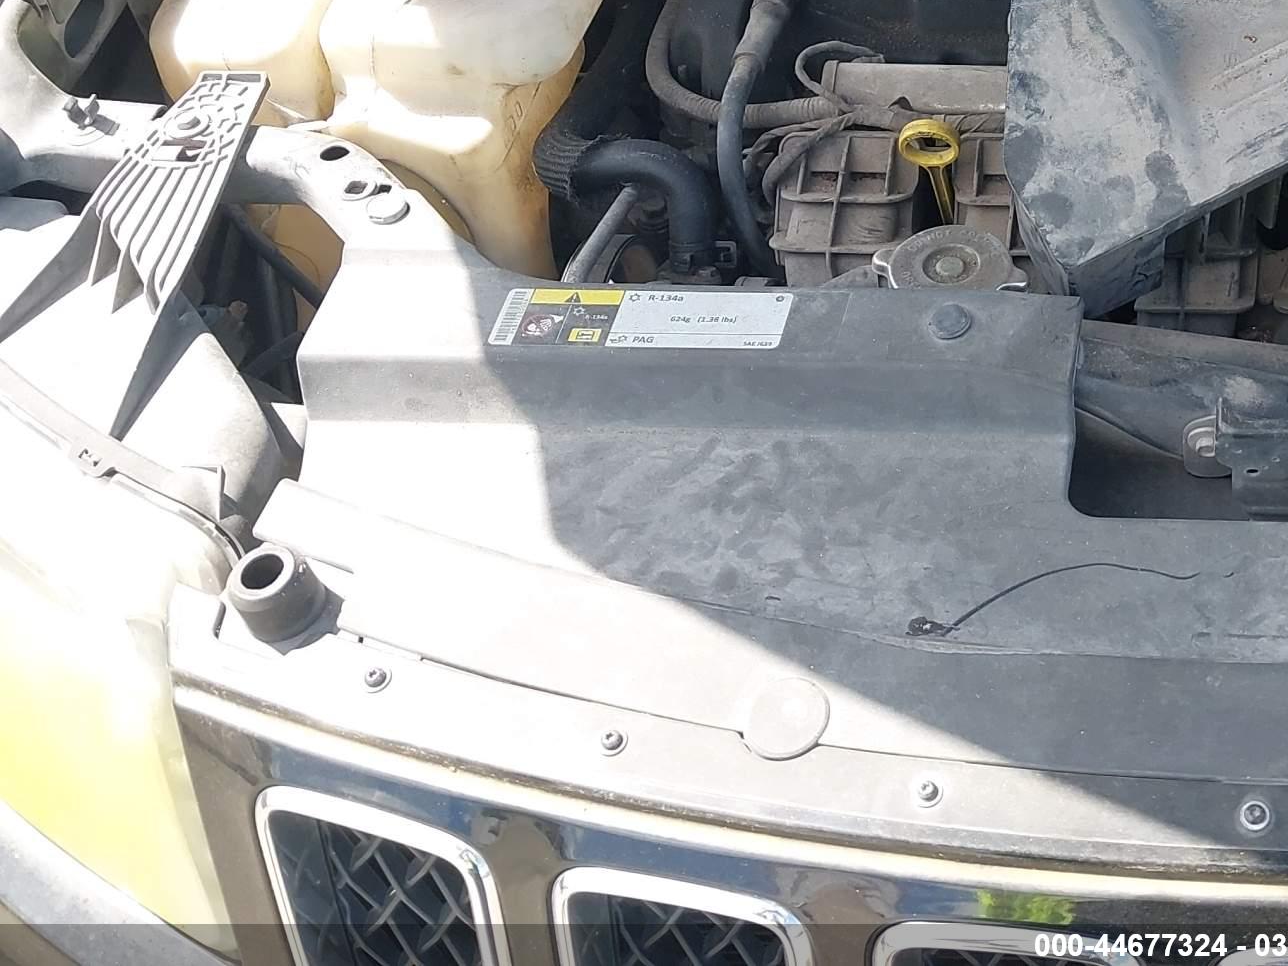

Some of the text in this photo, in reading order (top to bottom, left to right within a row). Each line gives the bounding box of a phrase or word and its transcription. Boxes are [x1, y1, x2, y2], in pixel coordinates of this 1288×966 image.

[648, 294, 684, 302] R-134a
[721, 315, 737, 324] lbs)
[632, 336, 655, 344] PAG
